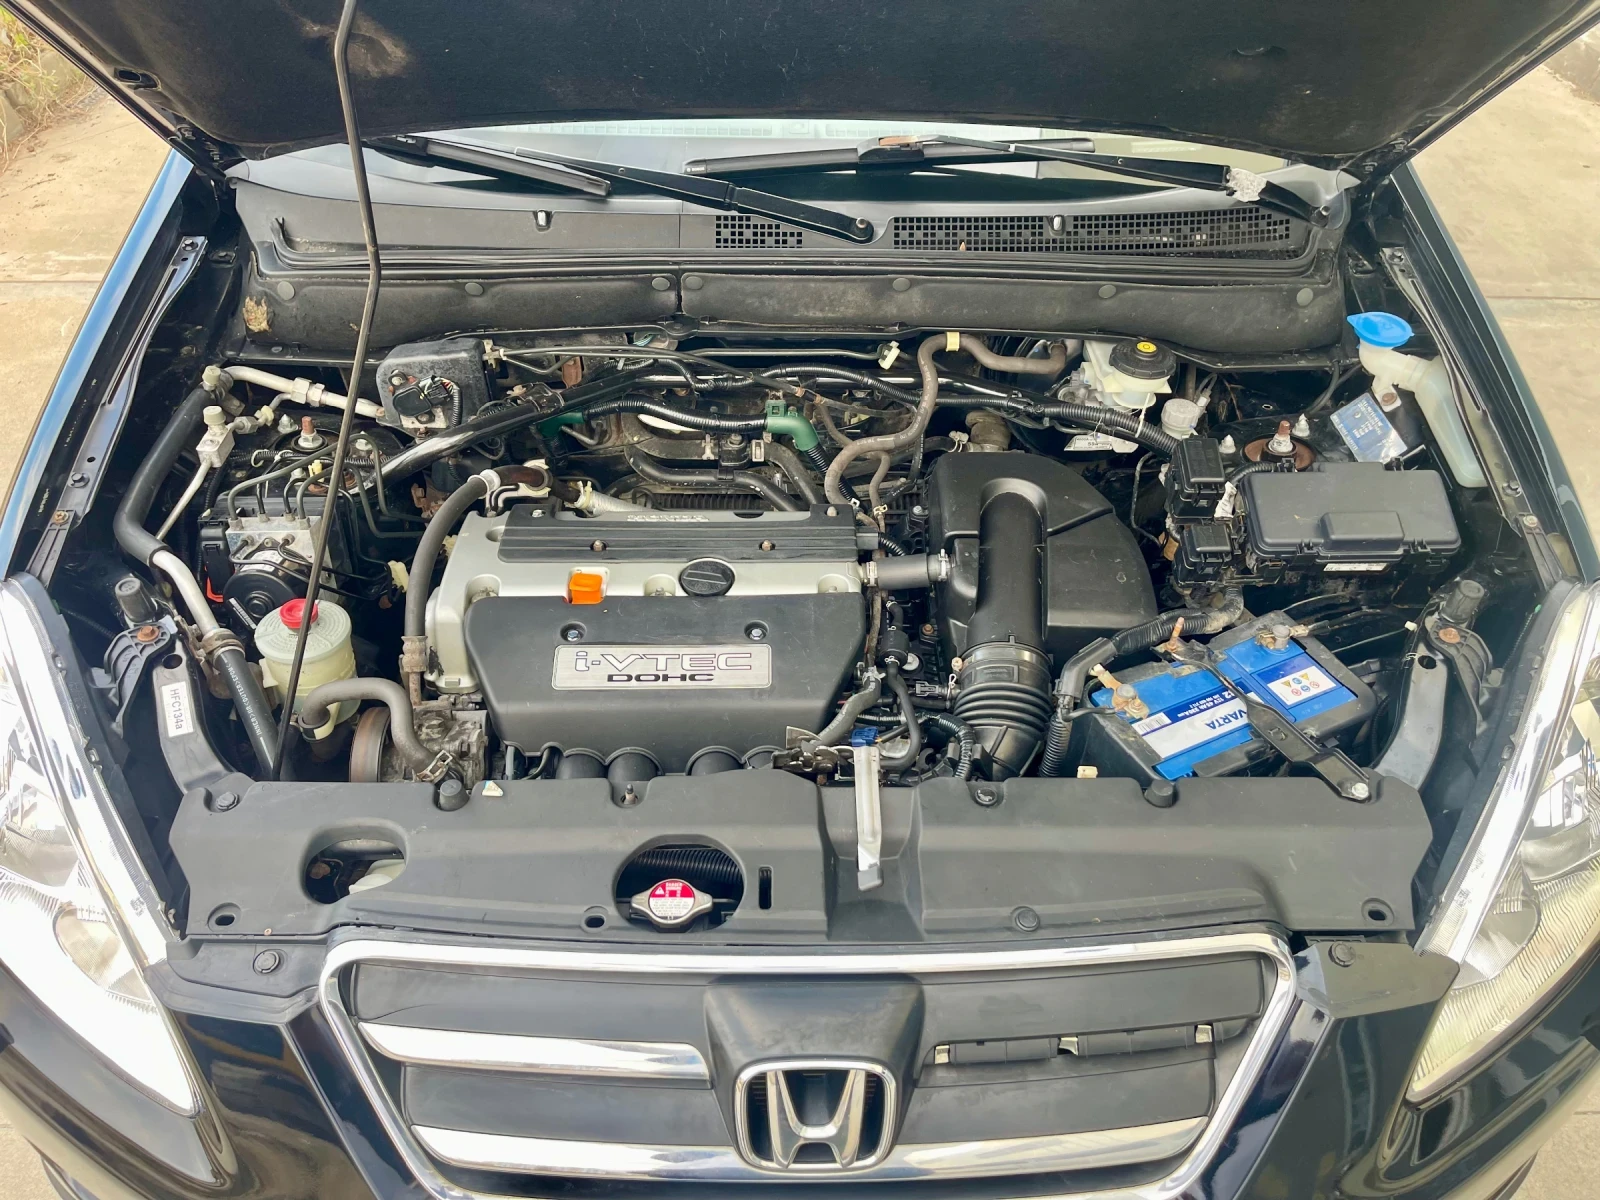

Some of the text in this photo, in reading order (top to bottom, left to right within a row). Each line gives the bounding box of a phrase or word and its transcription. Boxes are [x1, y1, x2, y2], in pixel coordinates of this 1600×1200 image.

[574, 650, 752, 672] i-VTEC
[606, 673, 715, 683] DOHC
[169, 688, 184, 730] HFC134a
[1204, 708, 1247, 730] VARTA
